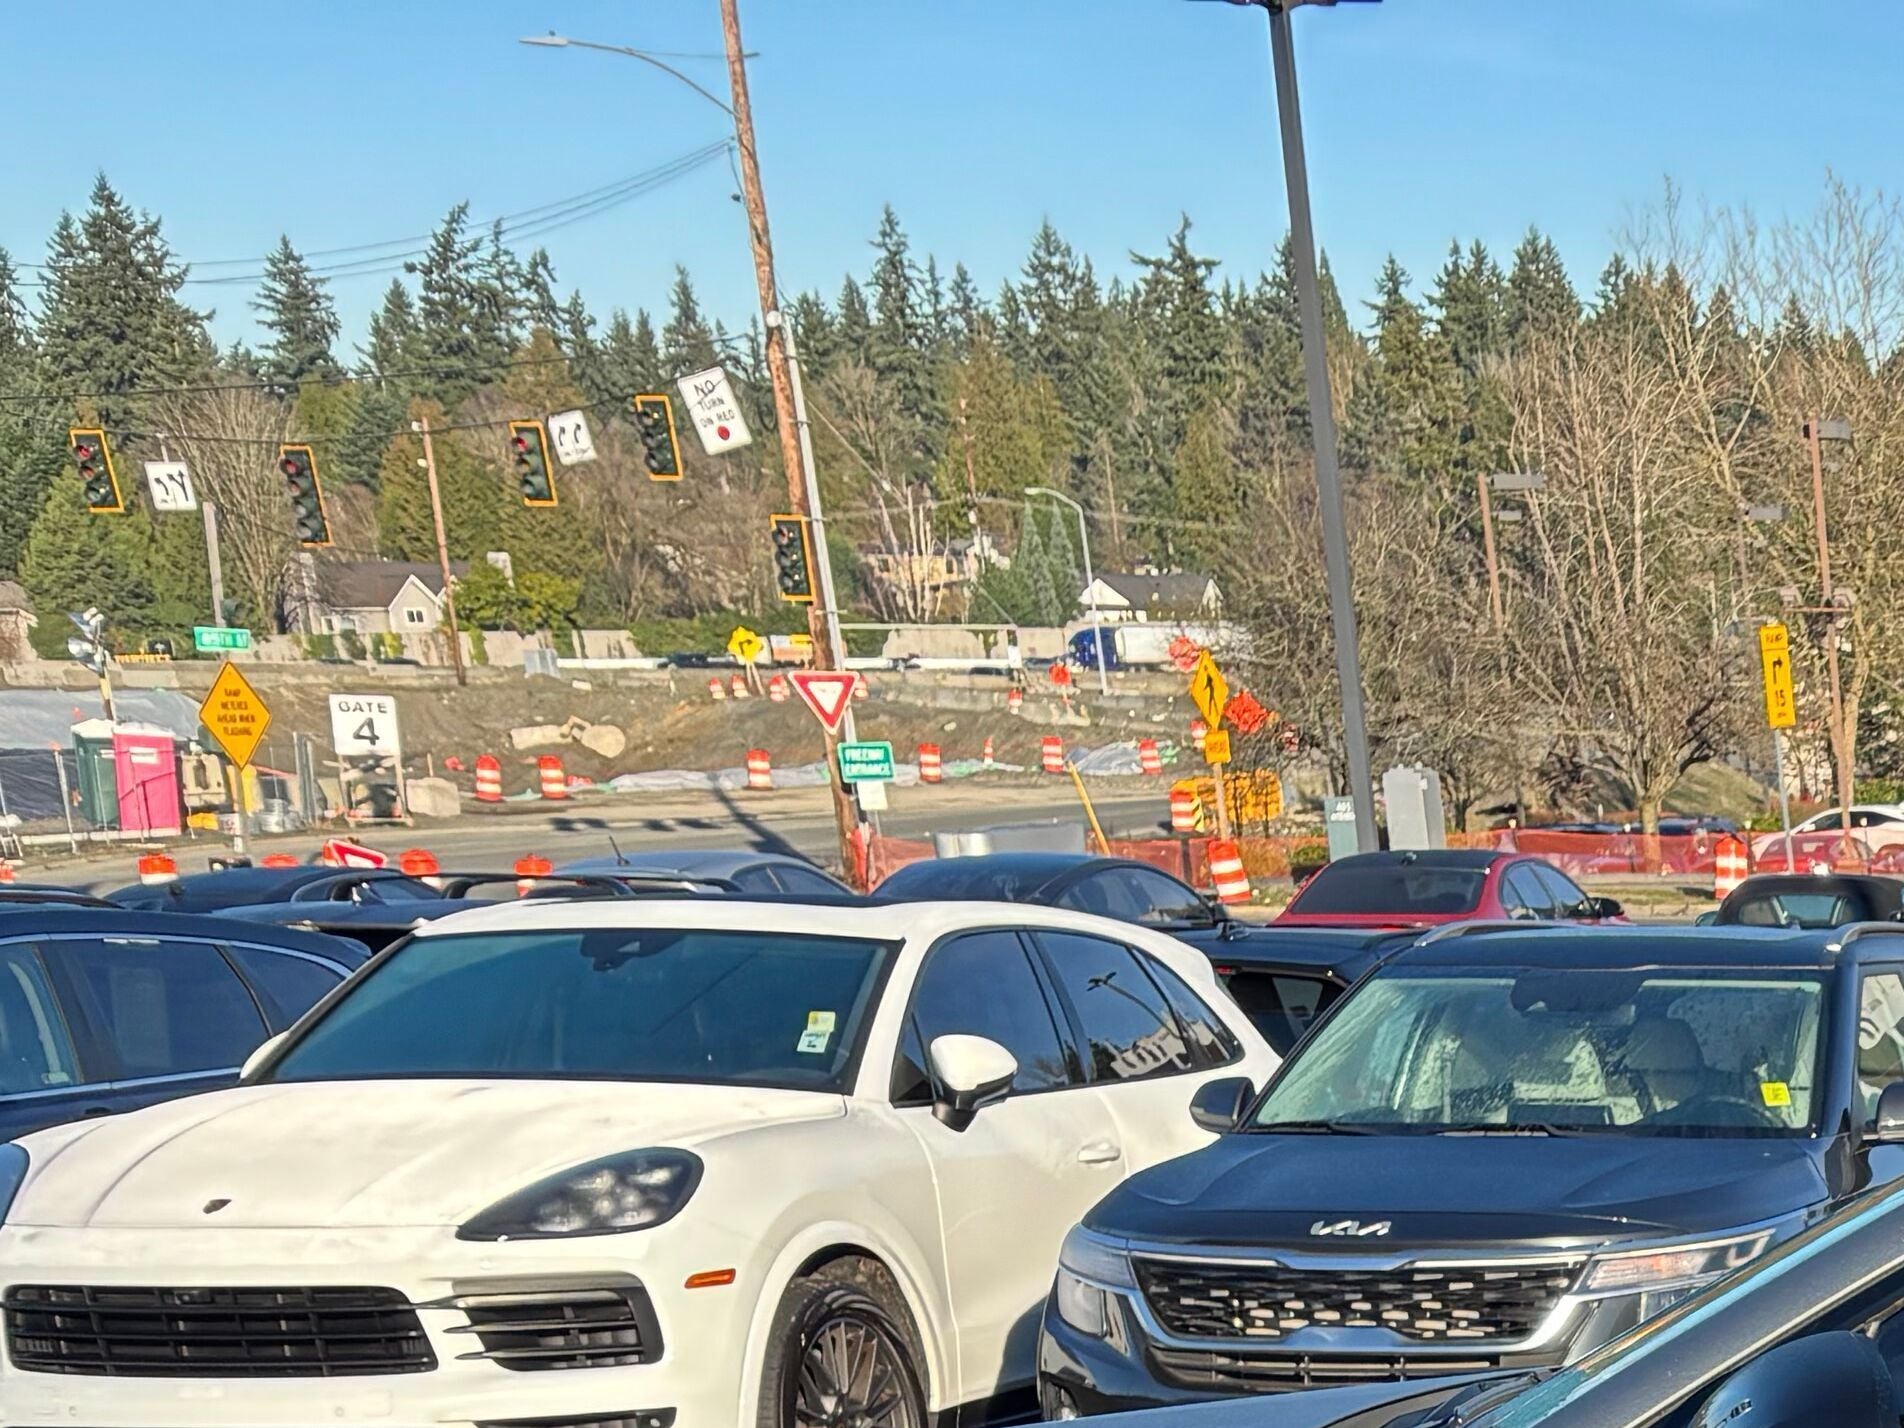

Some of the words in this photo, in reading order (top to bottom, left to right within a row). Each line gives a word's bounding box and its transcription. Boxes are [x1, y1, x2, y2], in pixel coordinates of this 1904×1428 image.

[693, 380, 716, 398] NO
[698, 397, 725, 411] TURN
[1775, 689, 1786, 707] 15
[338, 701, 388, 714] GATE
[353, 717, 380, 746] 4
